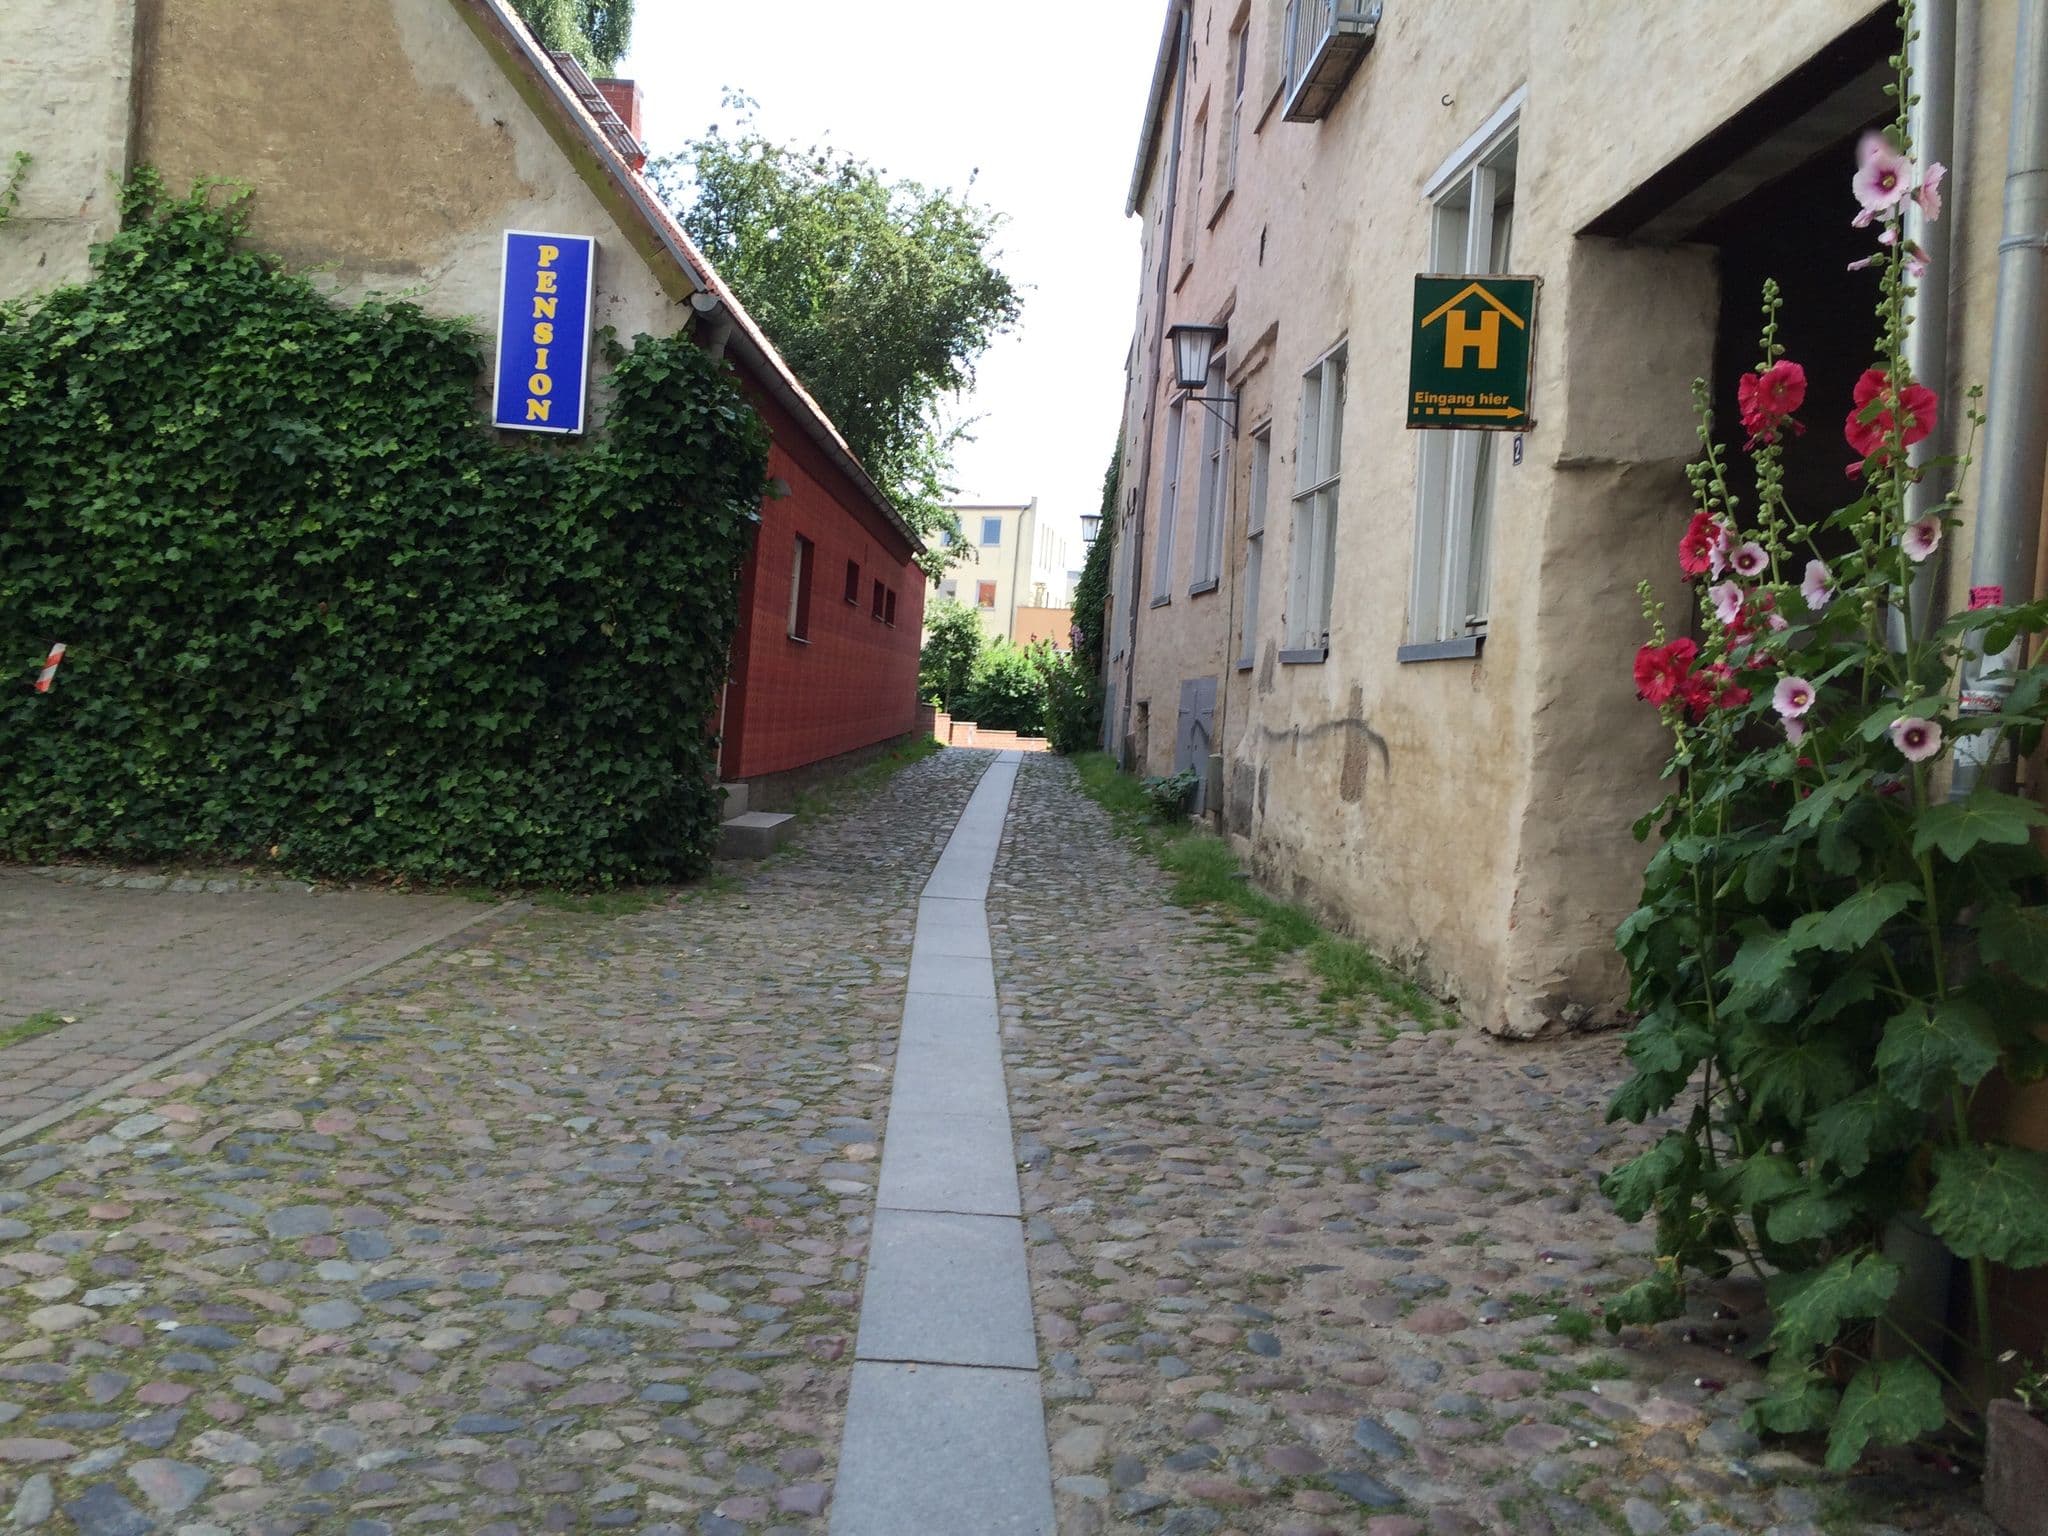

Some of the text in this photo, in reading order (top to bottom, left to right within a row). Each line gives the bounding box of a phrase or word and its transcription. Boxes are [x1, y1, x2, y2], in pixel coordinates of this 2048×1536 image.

[526, 244, 559, 421] PENSION
[1443, 310, 1500, 368] H
[1414, 391, 1509, 407] Eingang hier
